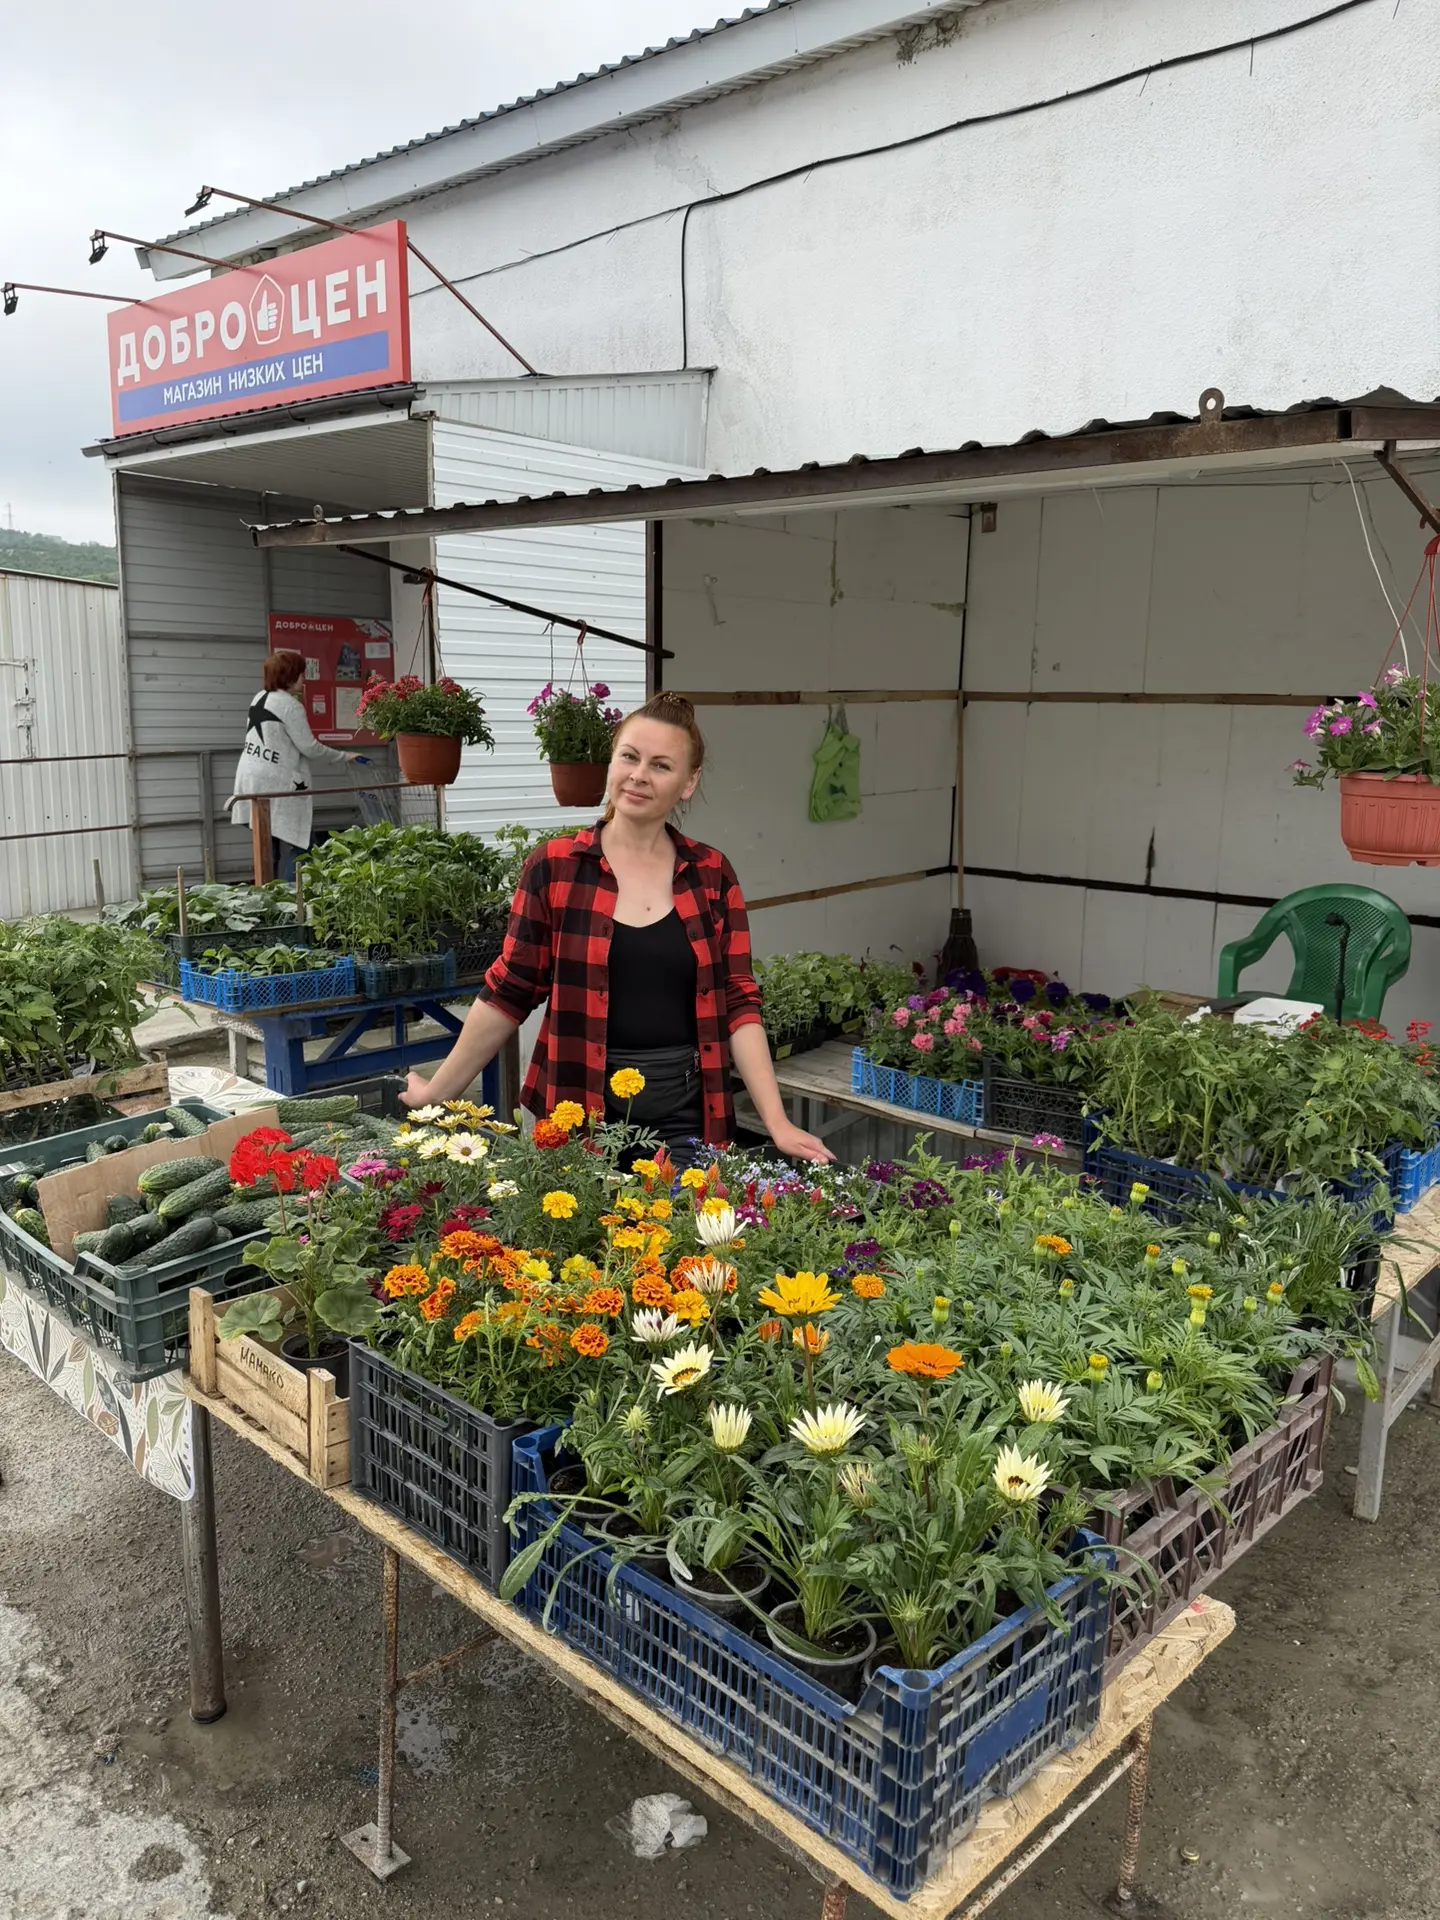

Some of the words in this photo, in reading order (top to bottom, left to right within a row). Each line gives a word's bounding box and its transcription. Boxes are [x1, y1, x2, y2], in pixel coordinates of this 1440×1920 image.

[118, 301, 247, 387] ДОБРО
[290, 259, 387, 339] ЦЕН
[163, 379, 222, 405] МАГАЗИН
[228, 361, 286, 392] НИЗКИХ
[292, 352, 324, 380] ЦЕН
[275, 620, 308, 630] ДОБРО
[315, 623, 334, 632] ЦЕН
